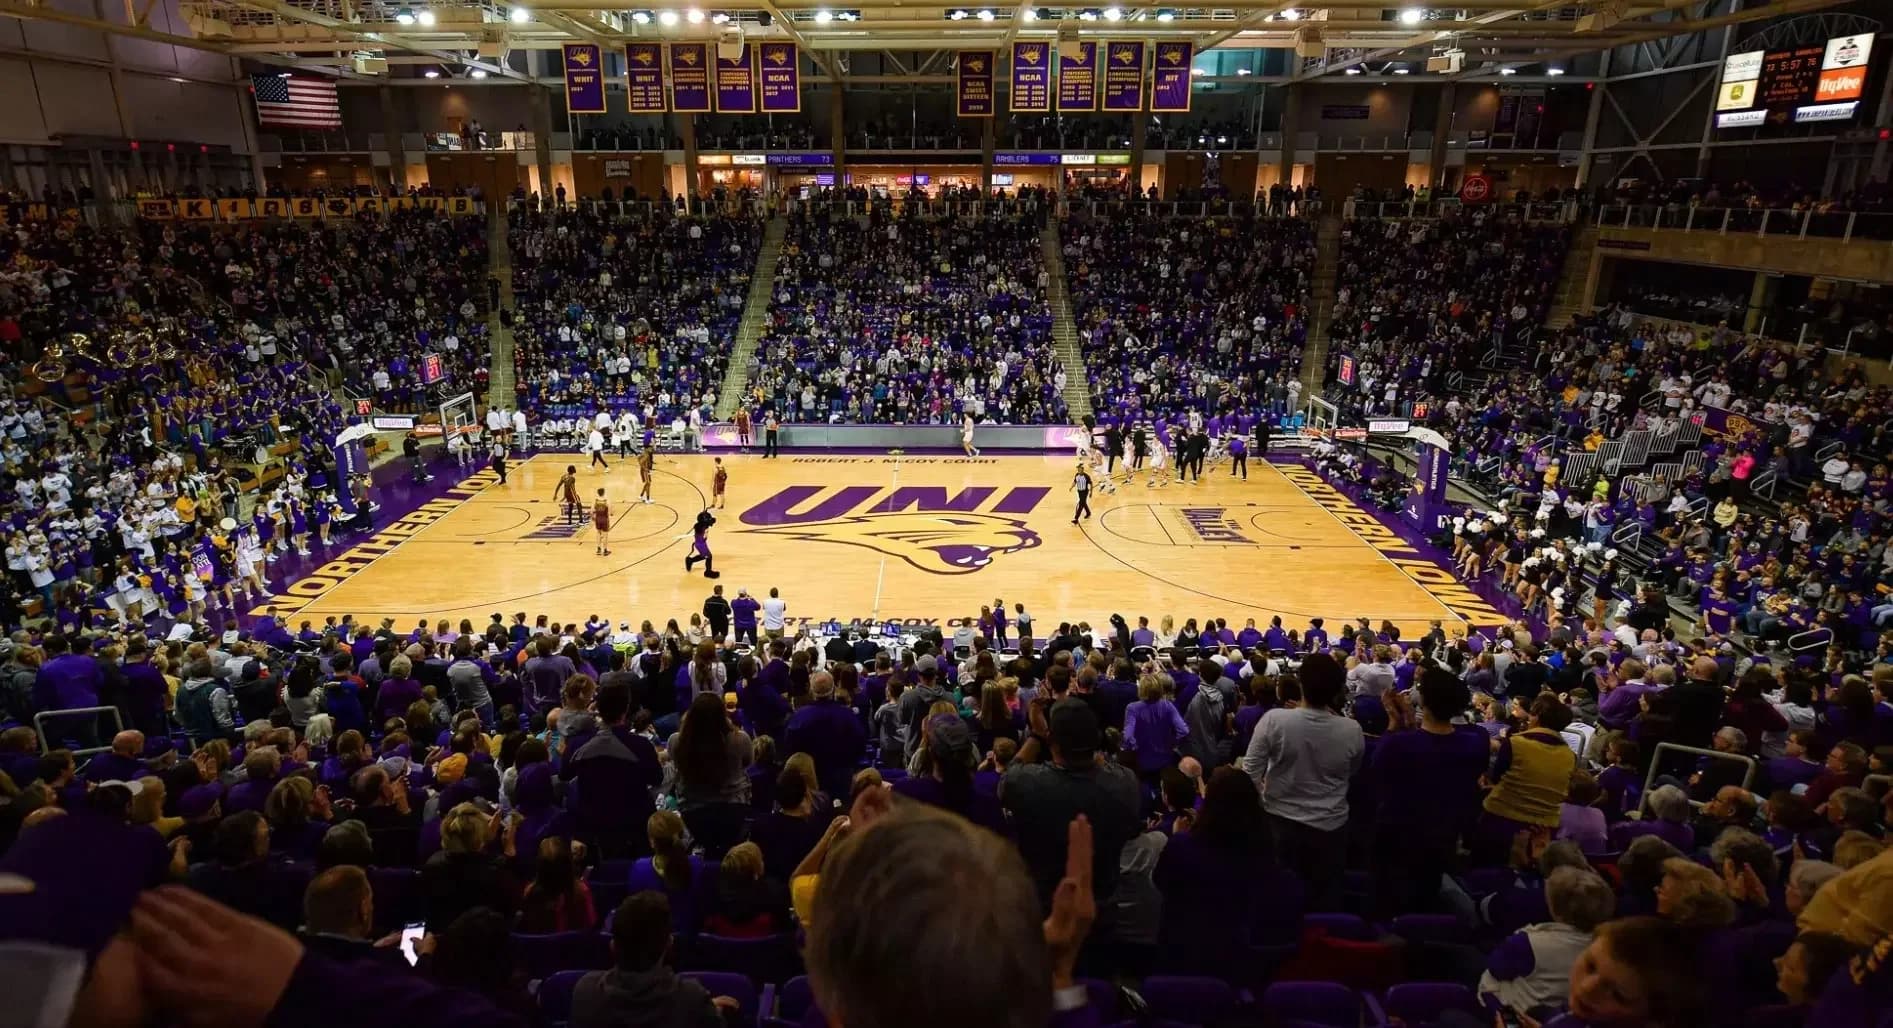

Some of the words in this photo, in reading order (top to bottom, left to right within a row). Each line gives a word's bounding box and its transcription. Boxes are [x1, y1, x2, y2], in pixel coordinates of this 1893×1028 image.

[739, 486, 1053, 525] UNI
[1224, 519, 1244, 530] THE
[1181, 508, 1259, 544] VALLEY
[1274, 464, 1419, 553] NORTHERN
[1390, 560, 1516, 627] IOWA
[248, 497, 456, 616] NORTHERN
